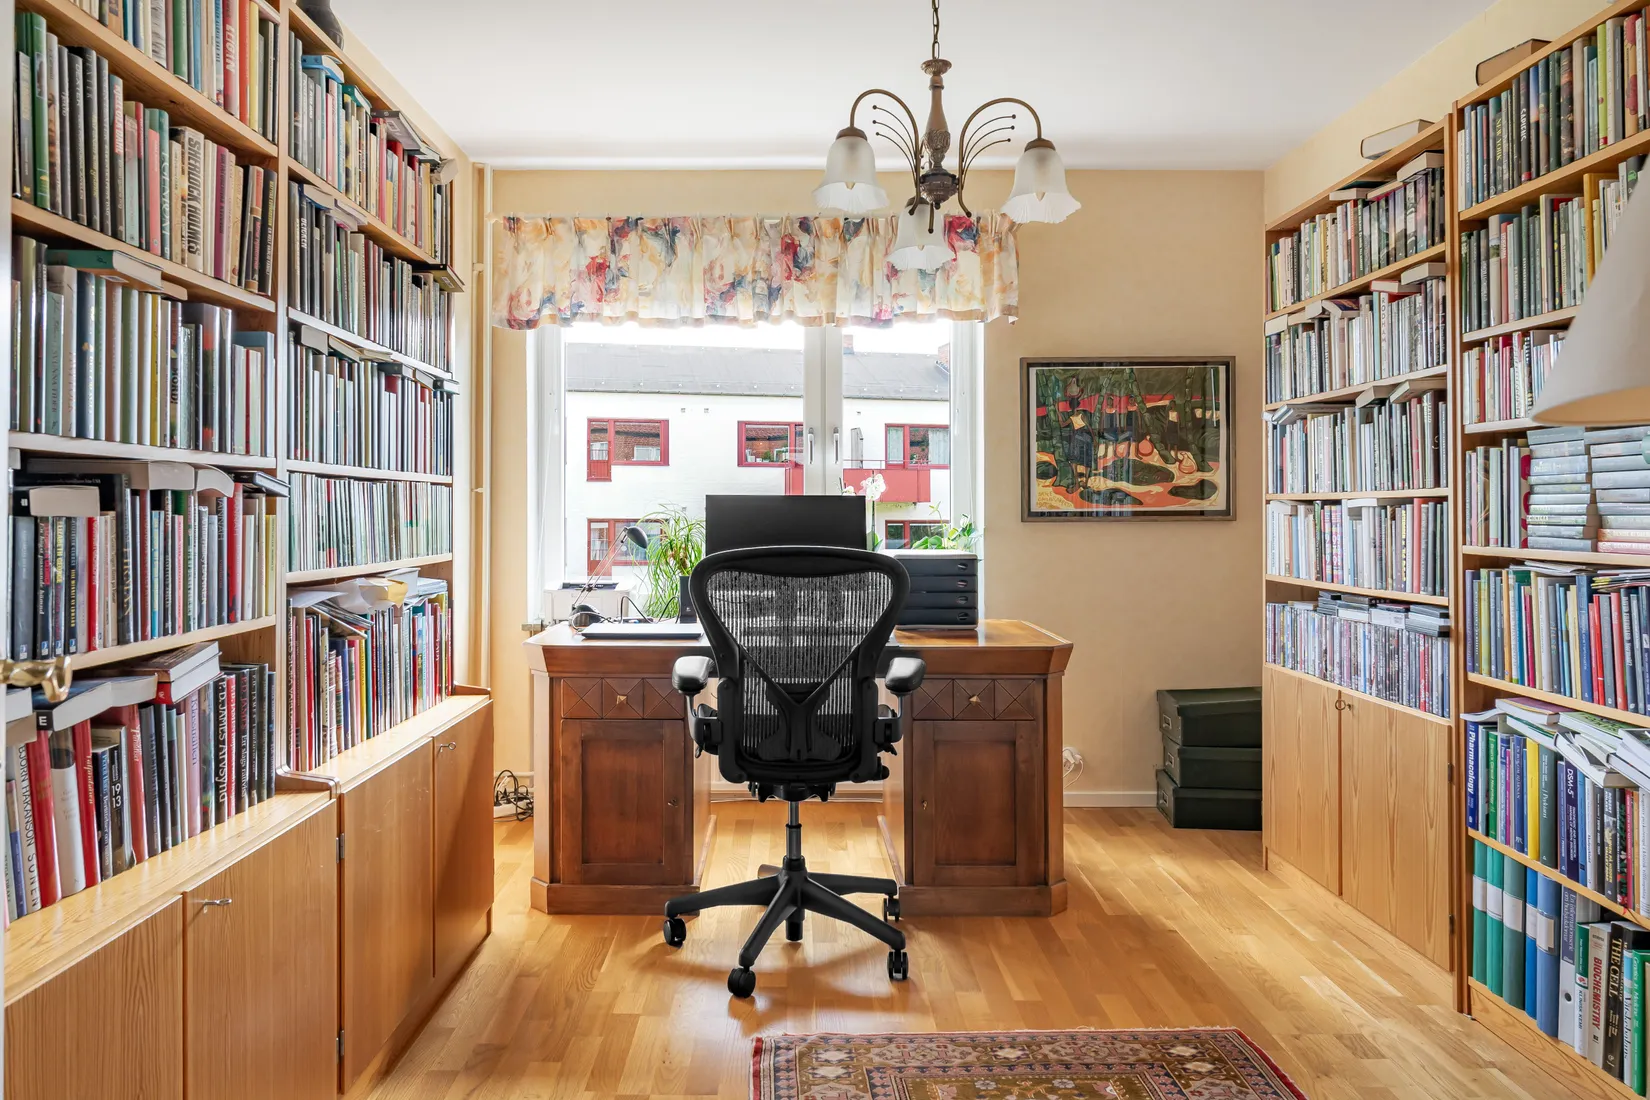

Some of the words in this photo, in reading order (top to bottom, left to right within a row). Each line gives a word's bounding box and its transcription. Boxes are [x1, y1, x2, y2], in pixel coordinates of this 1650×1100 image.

[188, 137, 202, 202] SHERLOCK
[188, 204, 202, 256] HOLMES
[171, 366, 179, 404] MORD!
[38, 716, 46, 726] E
[1468, 731, 1476, 794] Pharmacology
[112, 783, 122, 796] 19
[112, 796, 122, 808] 13
[1610, 938, 1622, 964] THE
[1592, 956, 1602, 1030] BIOCHEMISTRY
[1609, 964, 1620, 998] CELL
